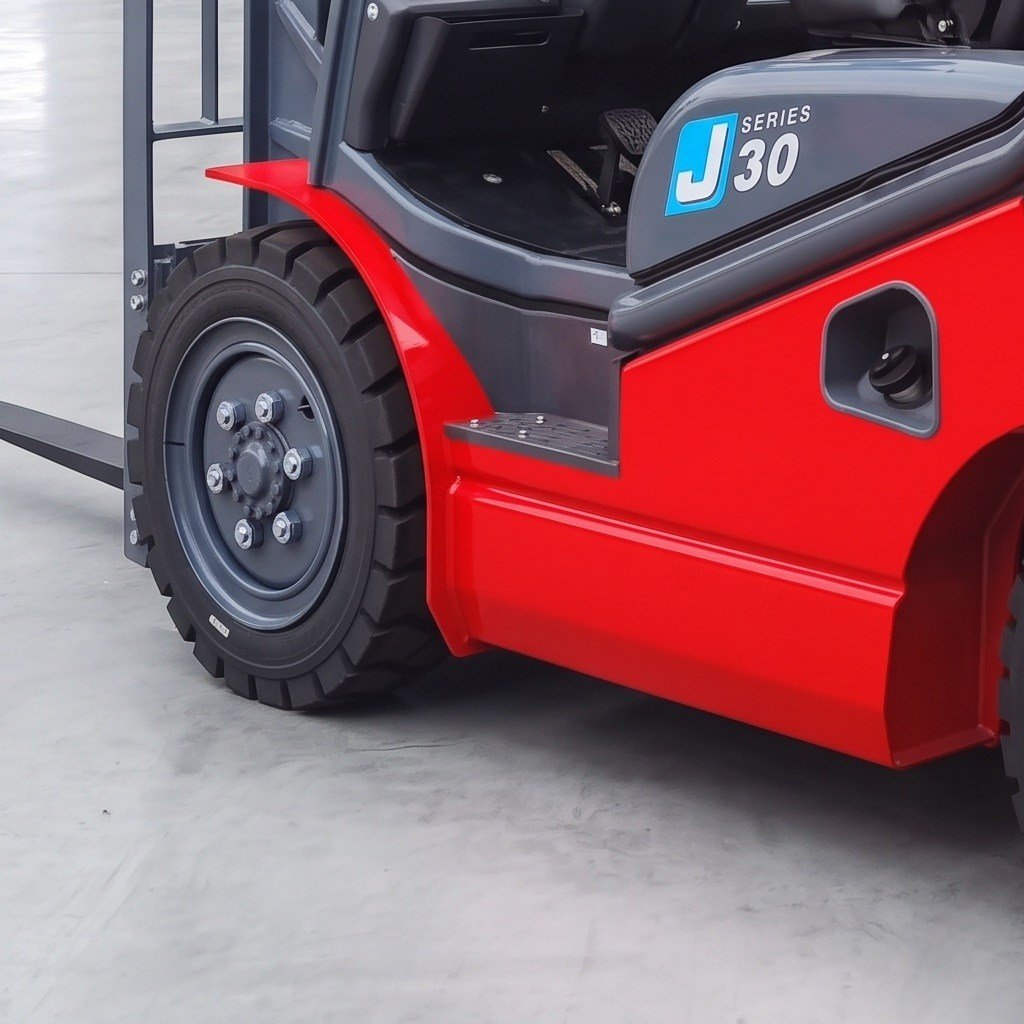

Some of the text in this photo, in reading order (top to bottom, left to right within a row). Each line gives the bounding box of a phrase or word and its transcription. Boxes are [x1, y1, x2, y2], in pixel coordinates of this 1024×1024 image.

[741, 104, 811, 134] SERIES
[676, 122, 799, 203] J 30
